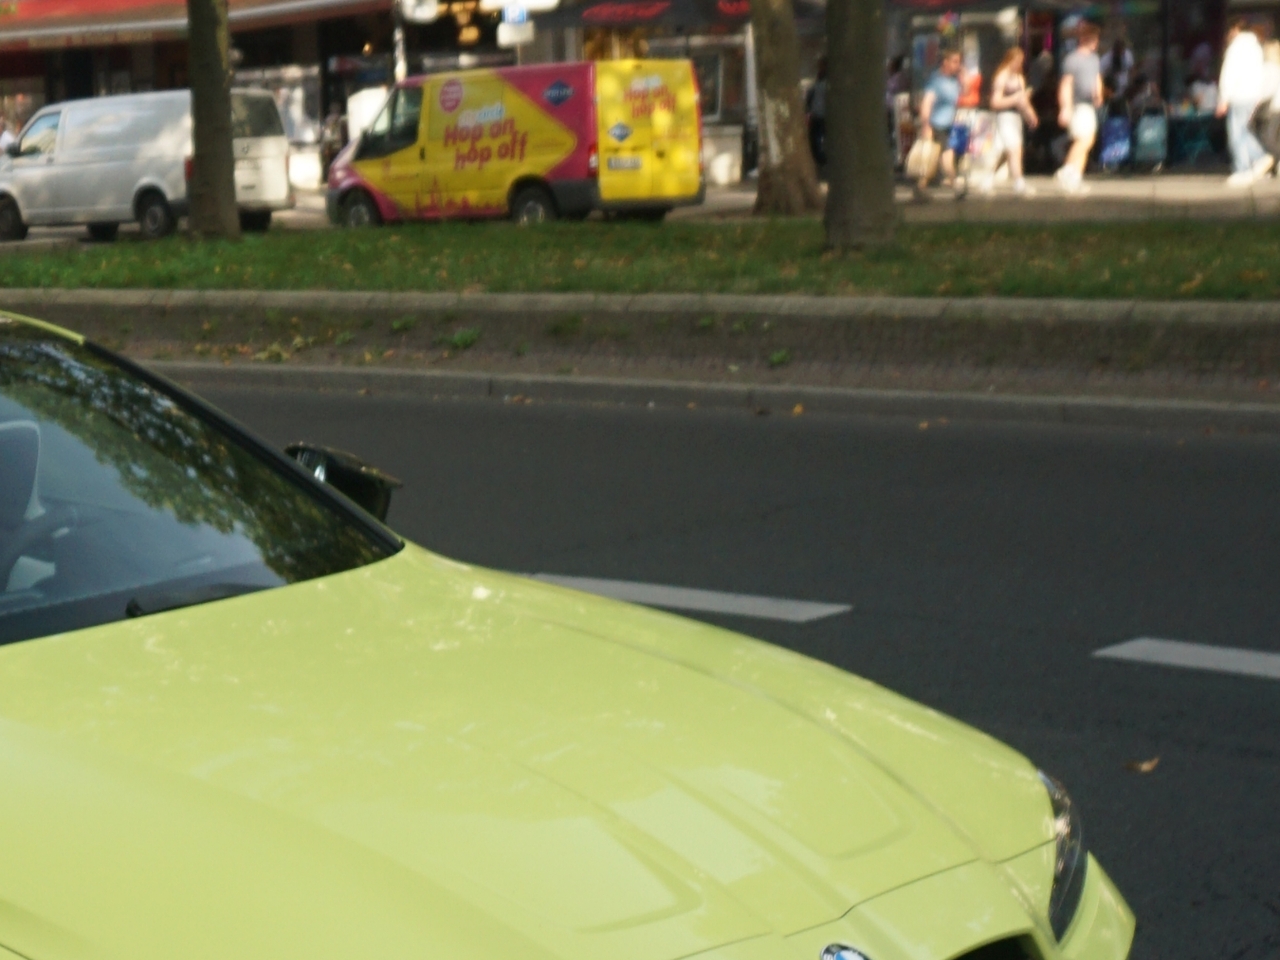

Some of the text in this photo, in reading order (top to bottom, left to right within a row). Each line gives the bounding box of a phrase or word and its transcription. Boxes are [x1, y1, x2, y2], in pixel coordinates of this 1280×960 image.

[444, 118, 516, 148] Hop on
[454, 130, 528, 170] hop off
